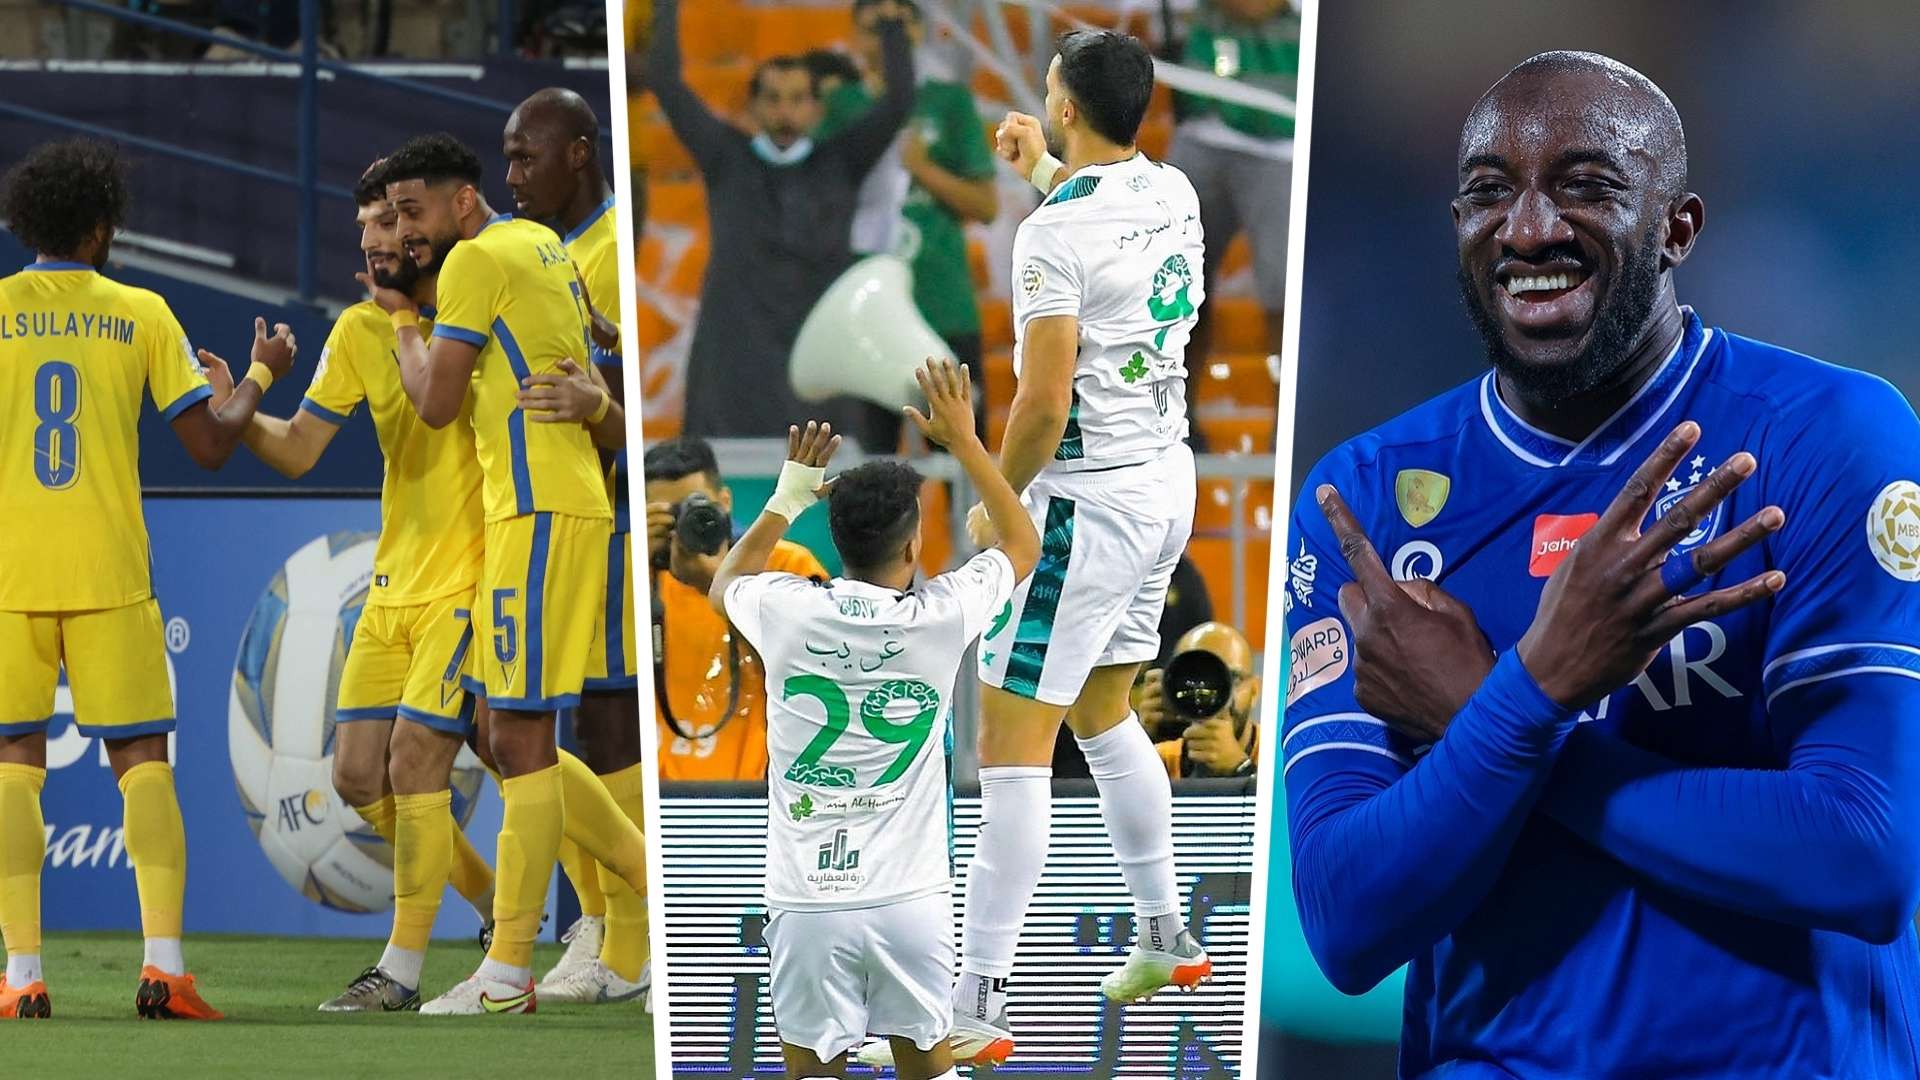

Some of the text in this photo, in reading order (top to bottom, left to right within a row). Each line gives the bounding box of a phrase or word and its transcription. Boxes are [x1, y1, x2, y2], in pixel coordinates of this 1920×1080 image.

[0, 311, 135, 345] LSULAYHIM
[34, 360, 82, 490] 8
[1897, 521, 1920, 538] MBS
[441, 607, 473, 682] 7
[492, 588, 518, 666] 5
[805, 629, 905, 673] غريب
[783, 672, 940, 788] 29
[277, 788, 327, 833] AFC
